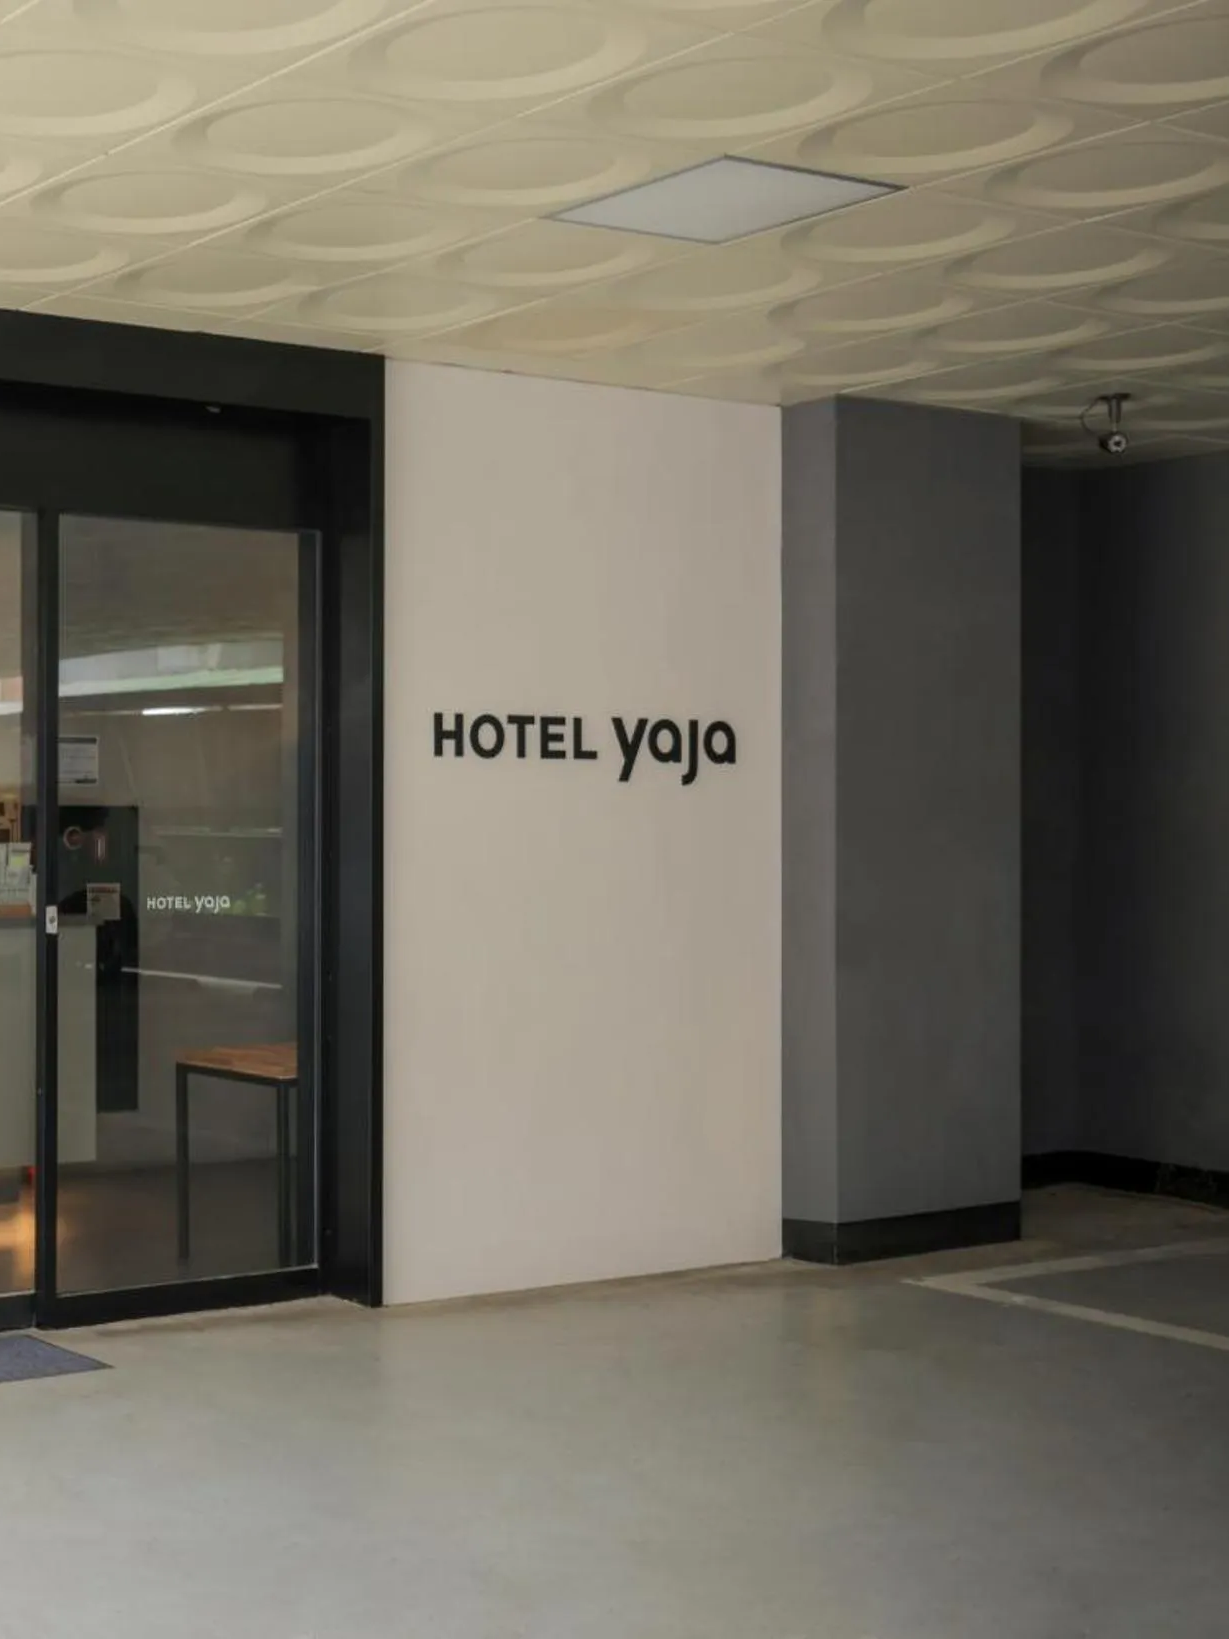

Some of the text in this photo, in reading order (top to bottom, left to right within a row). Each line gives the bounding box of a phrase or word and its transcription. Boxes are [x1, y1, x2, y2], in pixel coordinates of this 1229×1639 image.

[433, 712, 737, 786] HOTEL yaja
[146, 894, 231, 914] HOTEL yaja
